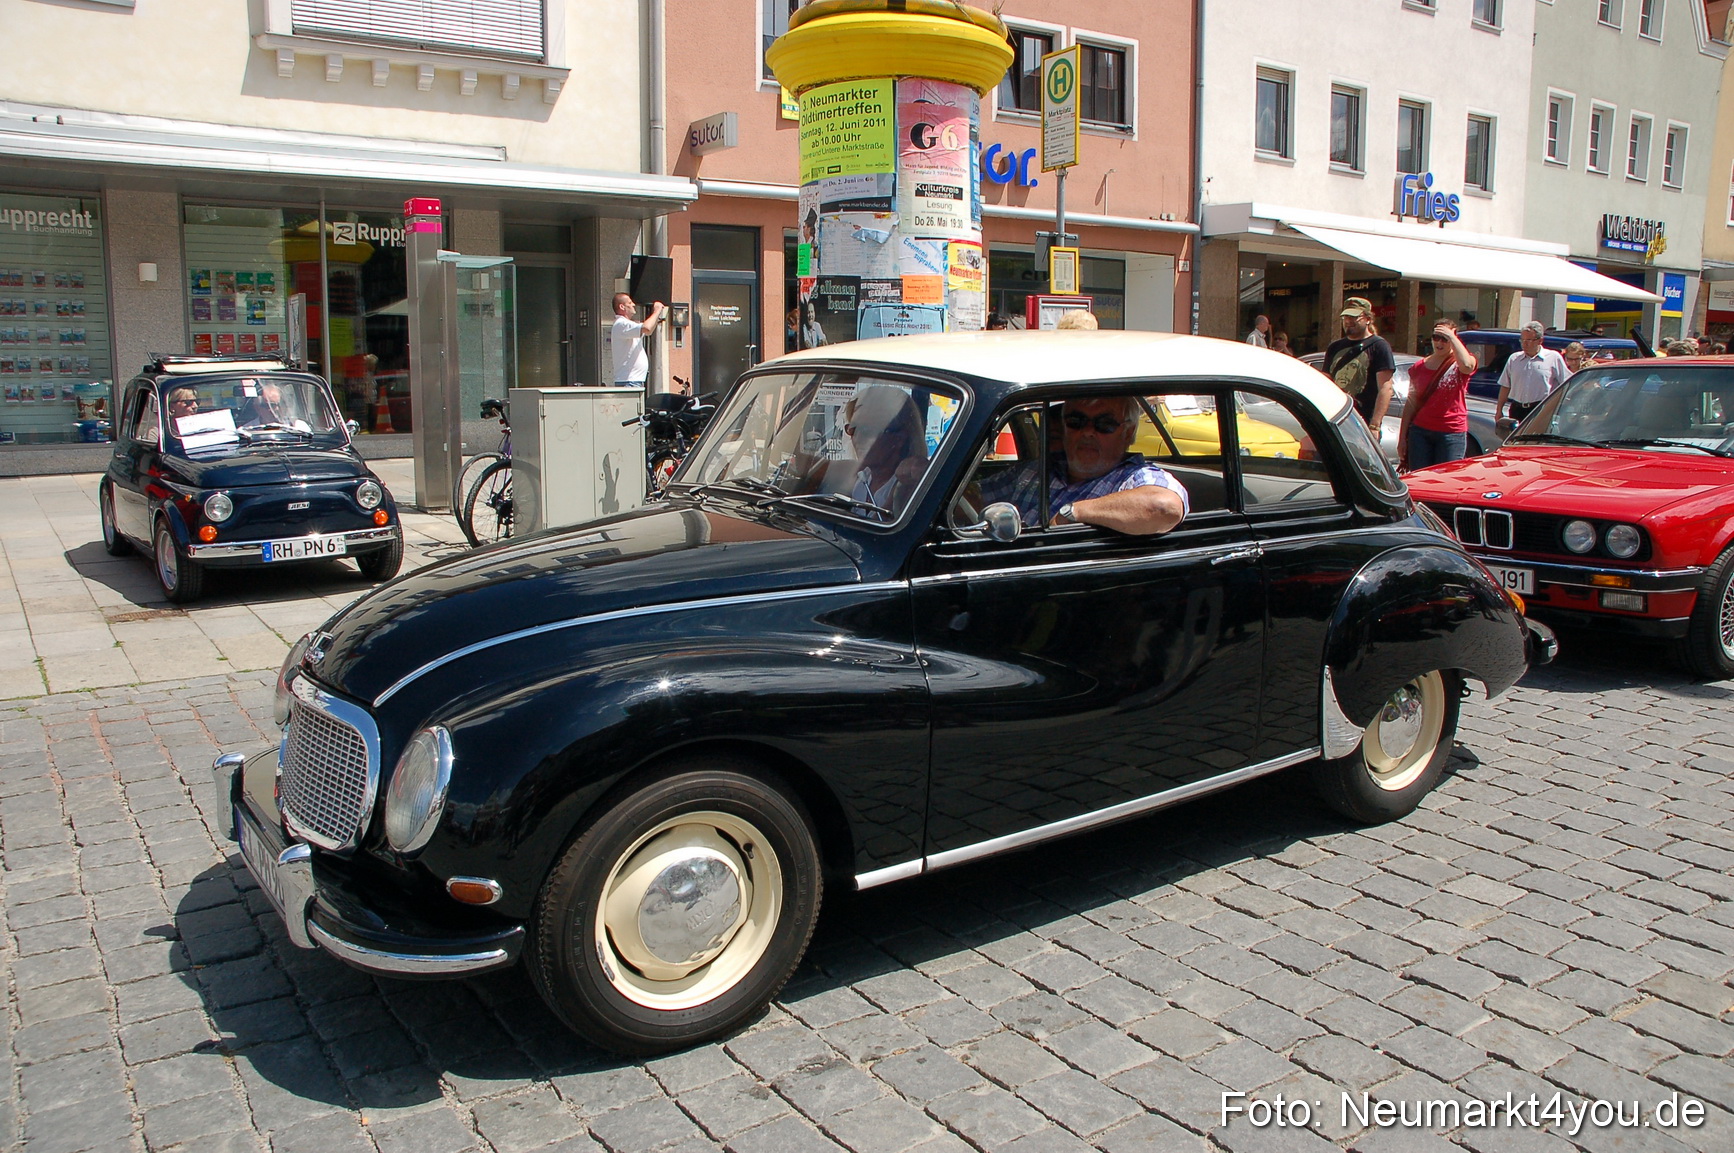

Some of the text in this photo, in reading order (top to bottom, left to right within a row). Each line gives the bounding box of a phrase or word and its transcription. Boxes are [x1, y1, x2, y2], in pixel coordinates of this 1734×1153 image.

[803, 100, 808, 111] 3.
[810, 88, 878, 109] Neumarkter
[801, 102, 881, 126] Oldtimertreffen
[1048, 106, 1072, 118] Marktplatz
[691, 122, 724, 147] sutor.
[801, 118, 886, 141] Sonntag, 12. Juni 2011
[910, 122, 958, 151] G6
[811, 133, 861, 148] ab 10.00 Uhr
[822, 147, 840, 155] Untere
[842, 142, 884, 152] Marktstraße
[915, 183, 959, 194] Kulturkreis
[925, 191, 954, 199] Neumarkt
[926, 201, 952, 211] Lesung
[915, 216, 925, 226] Do
[926, 216, 936, 227] 26.
[937, 217, 948, 228] Mai
[33, 225, 93, 236] Buchhandlung
[820, 280, 856, 295] allman
[1664, 286, 1681, 299] Bücher
[827, 296, 855, 310] band
[272, 539, 336, 558] RH PN 6
[1500, 569, 1525, 591] 191
